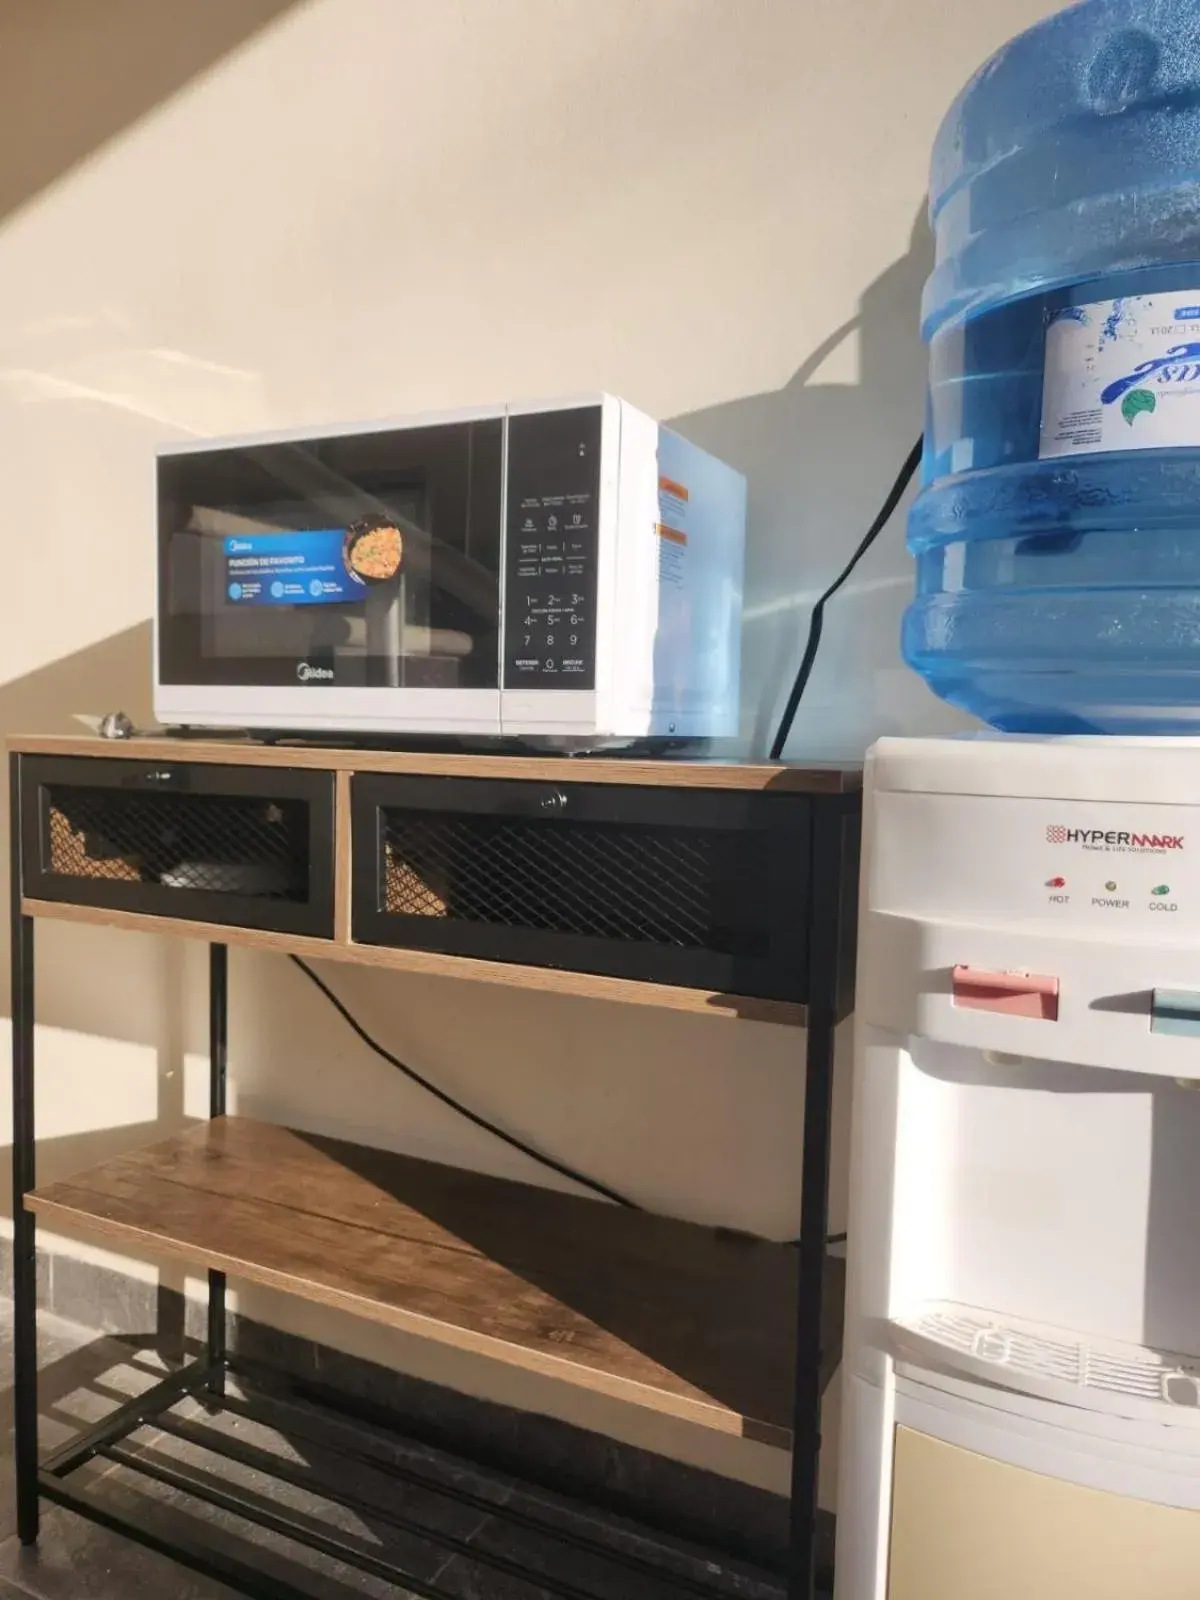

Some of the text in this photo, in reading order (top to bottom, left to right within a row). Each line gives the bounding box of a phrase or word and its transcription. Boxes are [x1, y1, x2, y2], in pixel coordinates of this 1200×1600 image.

[260, 557, 269, 566] DE
[547, 594, 554, 606] 2
[571, 593, 578, 605] 3
[524, 615, 531, 626] 4
[547, 614, 554, 626] 5
[570, 614, 578, 625] 6
[524, 634, 577, 646] 7 8 9
[1066, 829, 1185, 849] HYPERMARK
[1048, 895, 1070, 903] HOT
[1091, 897, 1130, 909] POWER
[1148, 902, 1178, 912] COLD
